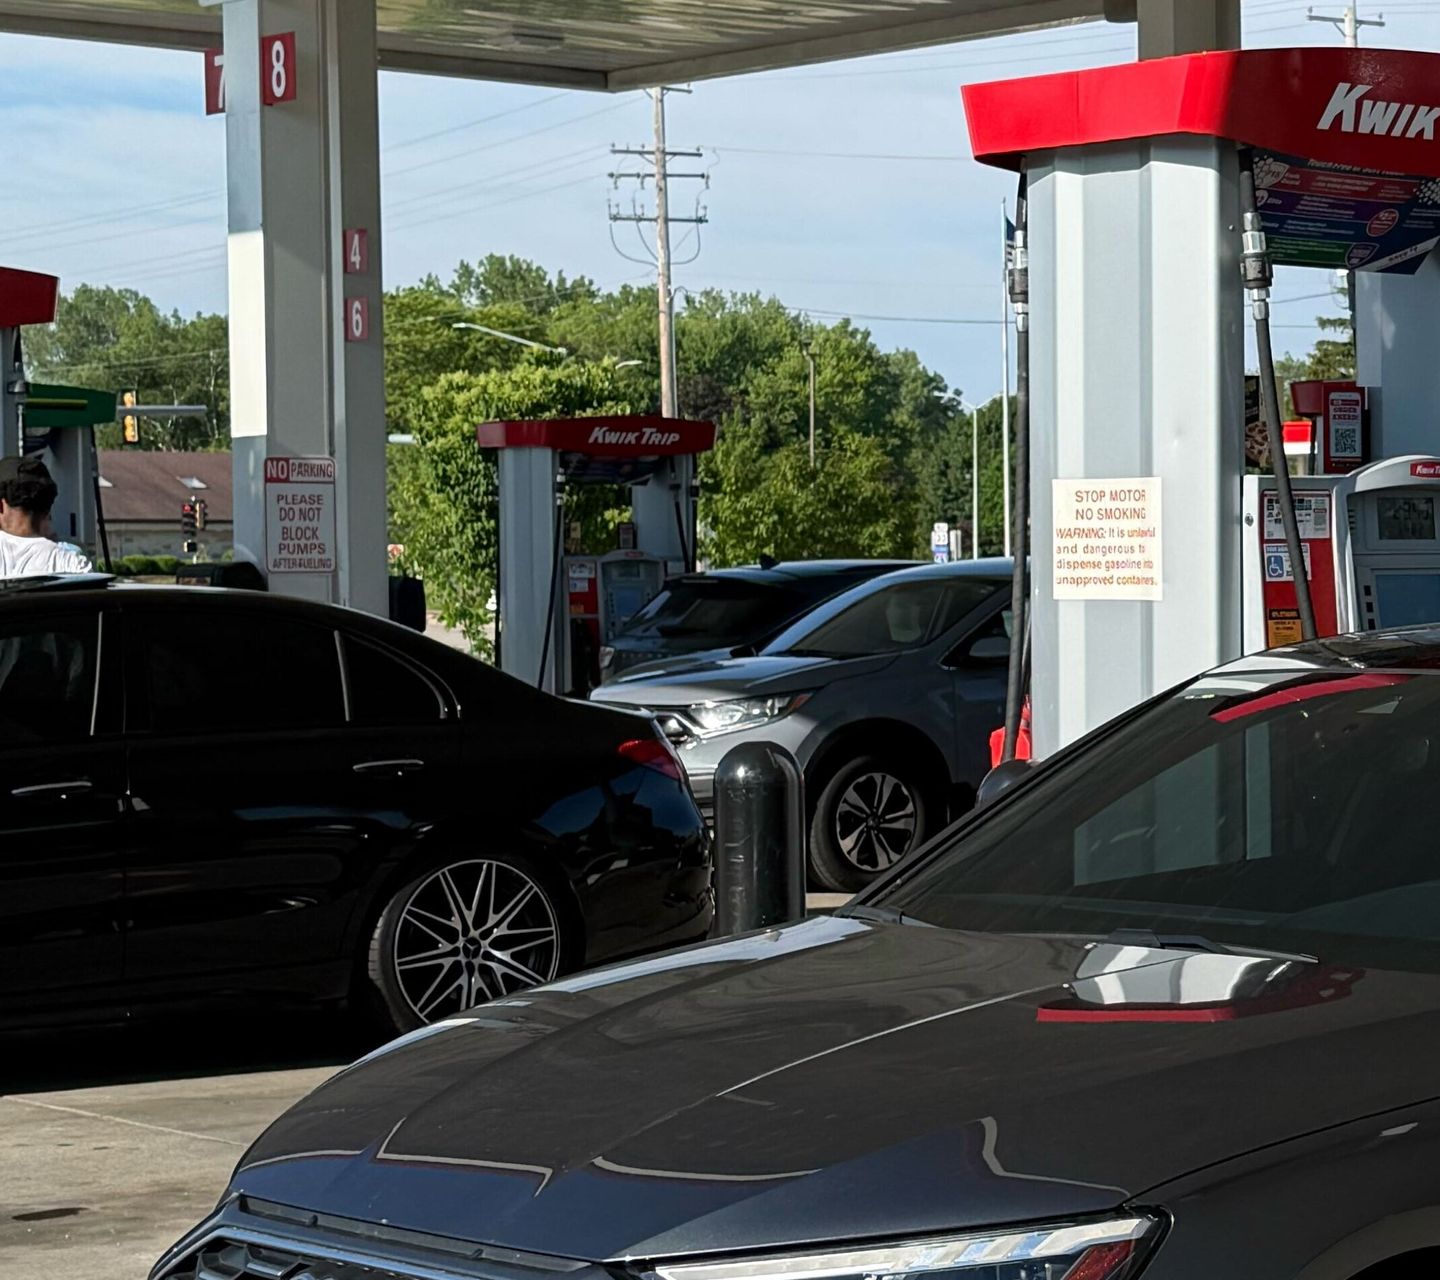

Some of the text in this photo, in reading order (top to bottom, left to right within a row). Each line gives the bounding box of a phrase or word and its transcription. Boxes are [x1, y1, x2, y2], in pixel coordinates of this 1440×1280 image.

[272, 40, 286, 98] 8
[350, 233, 361, 270] 4
[352, 300, 362, 337] 6
[267, 460, 332, 479] NO PARKING
[277, 494, 323, 505] PLEASE
[1075, 489, 1146, 502] STOP MOTOR
[279, 507, 322, 521] DO NOT
[1075, 507, 1146, 520] NO SMOKING
[281, 526, 319, 540] BLOCK
[1056, 527, 1106, 539] WARNING:
[1109, 527, 1115, 537] It
[1117, 527, 1125, 538] is
[278, 543, 326, 555] PUMPS
[1056, 544, 1078, 554] and
[1083, 544, 1135, 557] dangerous
[273, 558, 332, 569] AFTER FUELING
[1056, 559, 1102, 571] dispense
[1105, 559, 1141, 571] gasoline
[1056, 575, 1114, 588] unapproved
